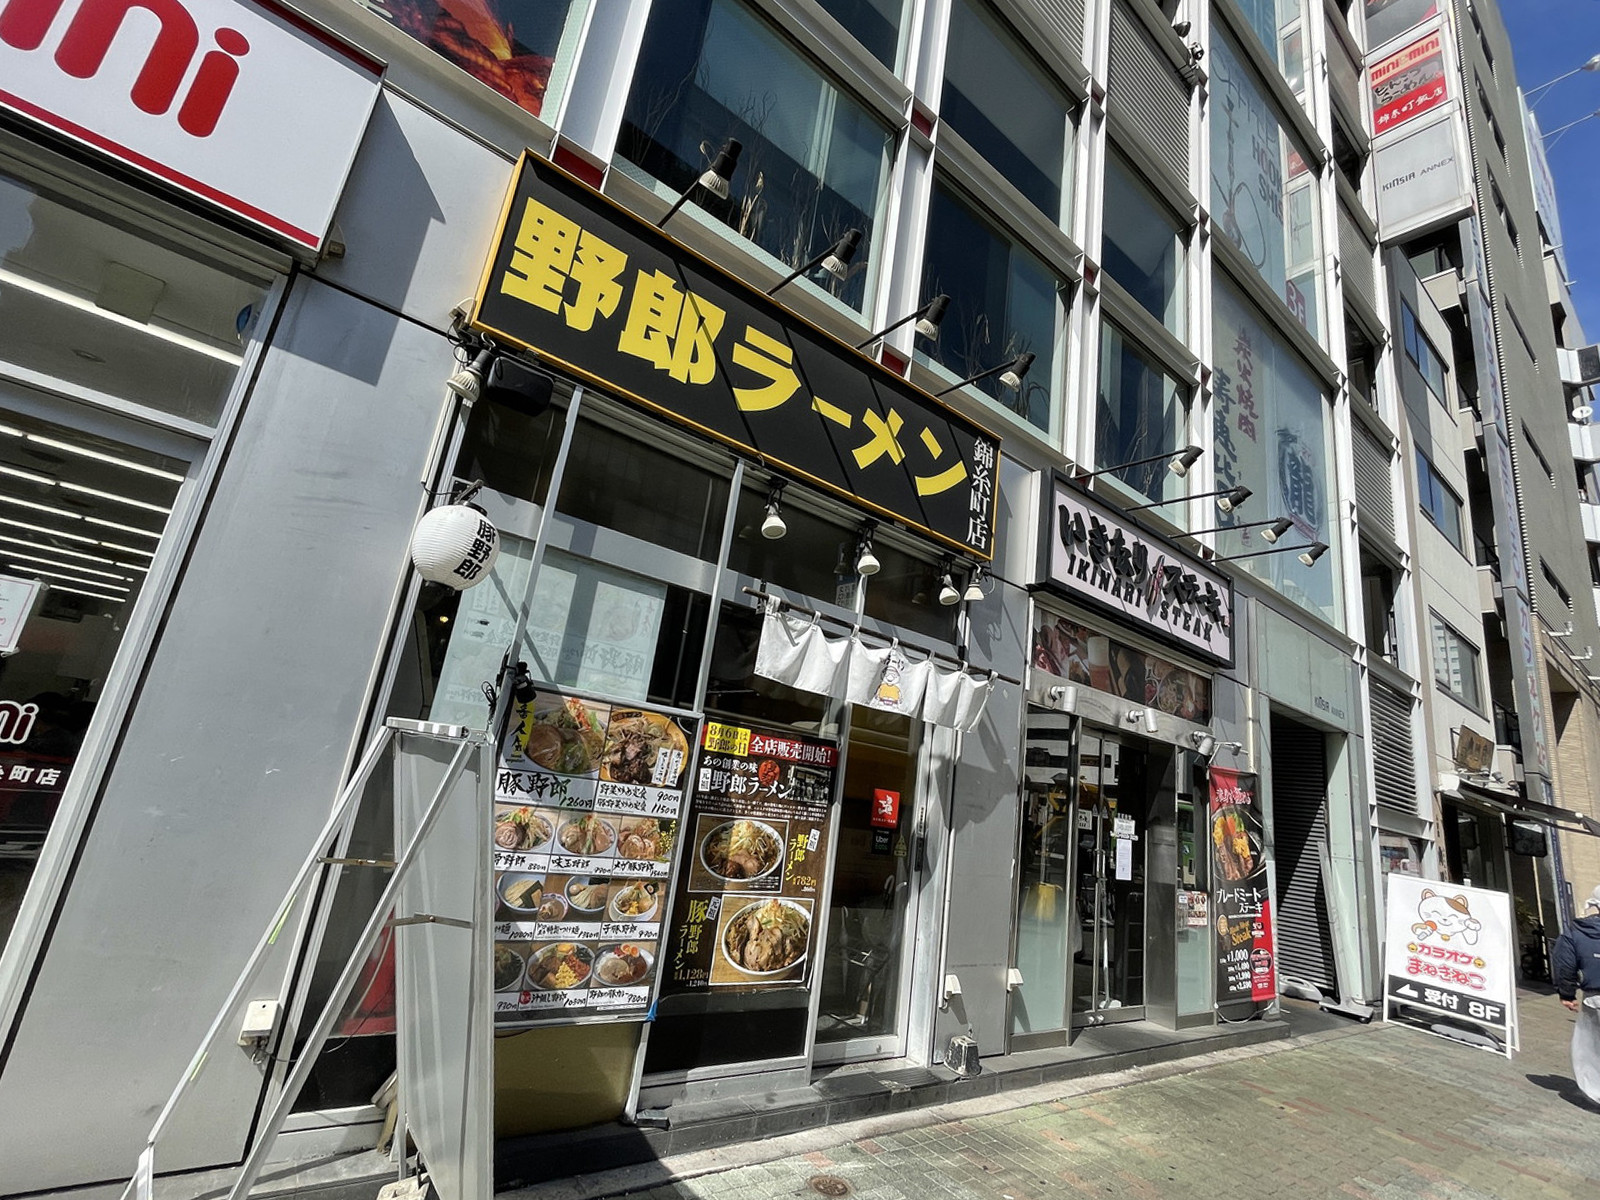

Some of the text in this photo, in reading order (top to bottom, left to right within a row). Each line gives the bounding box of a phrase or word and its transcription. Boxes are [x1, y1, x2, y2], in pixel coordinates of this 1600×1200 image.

[1420, 156, 1455, 176] ANNEX
[501, 197, 968, 496] 野郎ラーメン
[965, 436, 994, 550] 錦糸町店
[453, 519, 496, 580] 豚野郎
[1067, 554, 1213, 643] IKINARI STEAK
[497, 771, 571, 799] 豚野郎
[657, 791, 679, 802] 900円
[711, 770, 793, 799] 野郎ラーメン
[560, 797, 593, 808] 1260円
[651, 802, 677, 814] 1150円
[1239, 902, 1263, 913] ステーキ
[1418, 943, 1474, 965] カラオケ
[1407, 957, 1486, 991] まねきねこ
[1424, 988, 1500, 1021] 受付 8F
